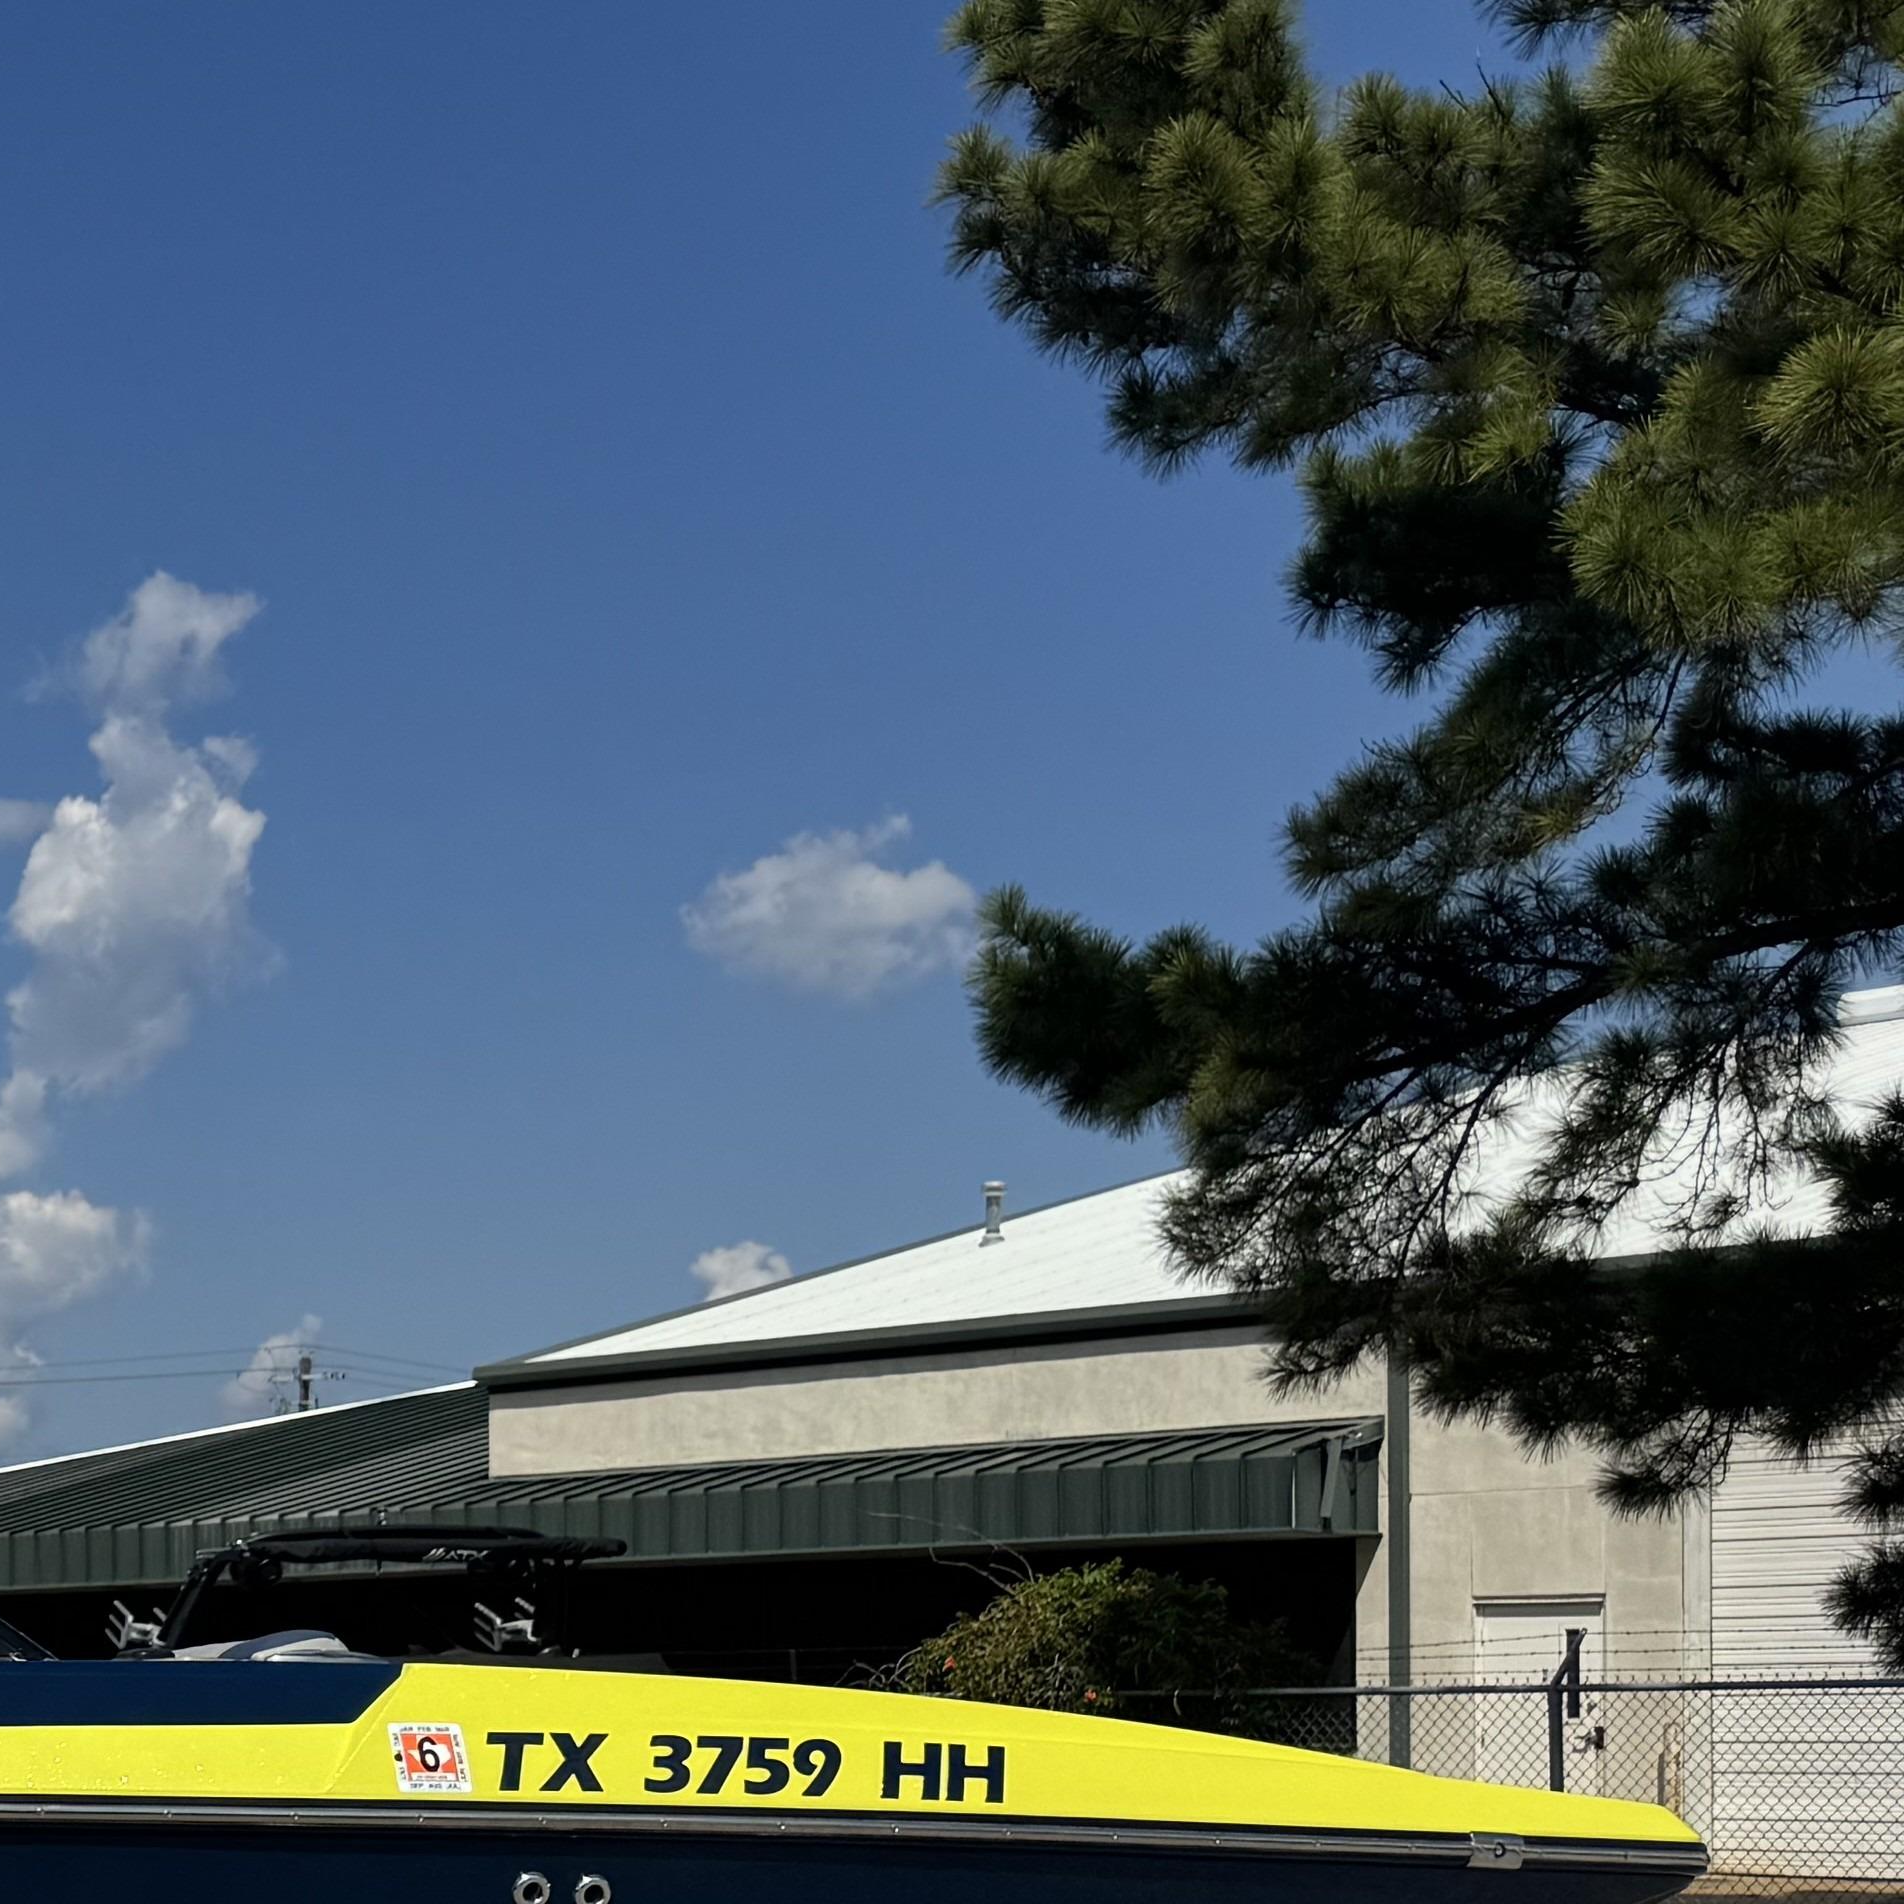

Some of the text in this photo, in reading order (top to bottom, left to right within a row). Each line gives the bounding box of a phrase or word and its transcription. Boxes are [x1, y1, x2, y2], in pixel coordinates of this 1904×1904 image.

[417, 1735, 440, 1773] 6
[485, 1732, 609, 1793] TX
[643, 1734, 842, 1797] 3759
[879, 1740, 1007, 1804] HH
